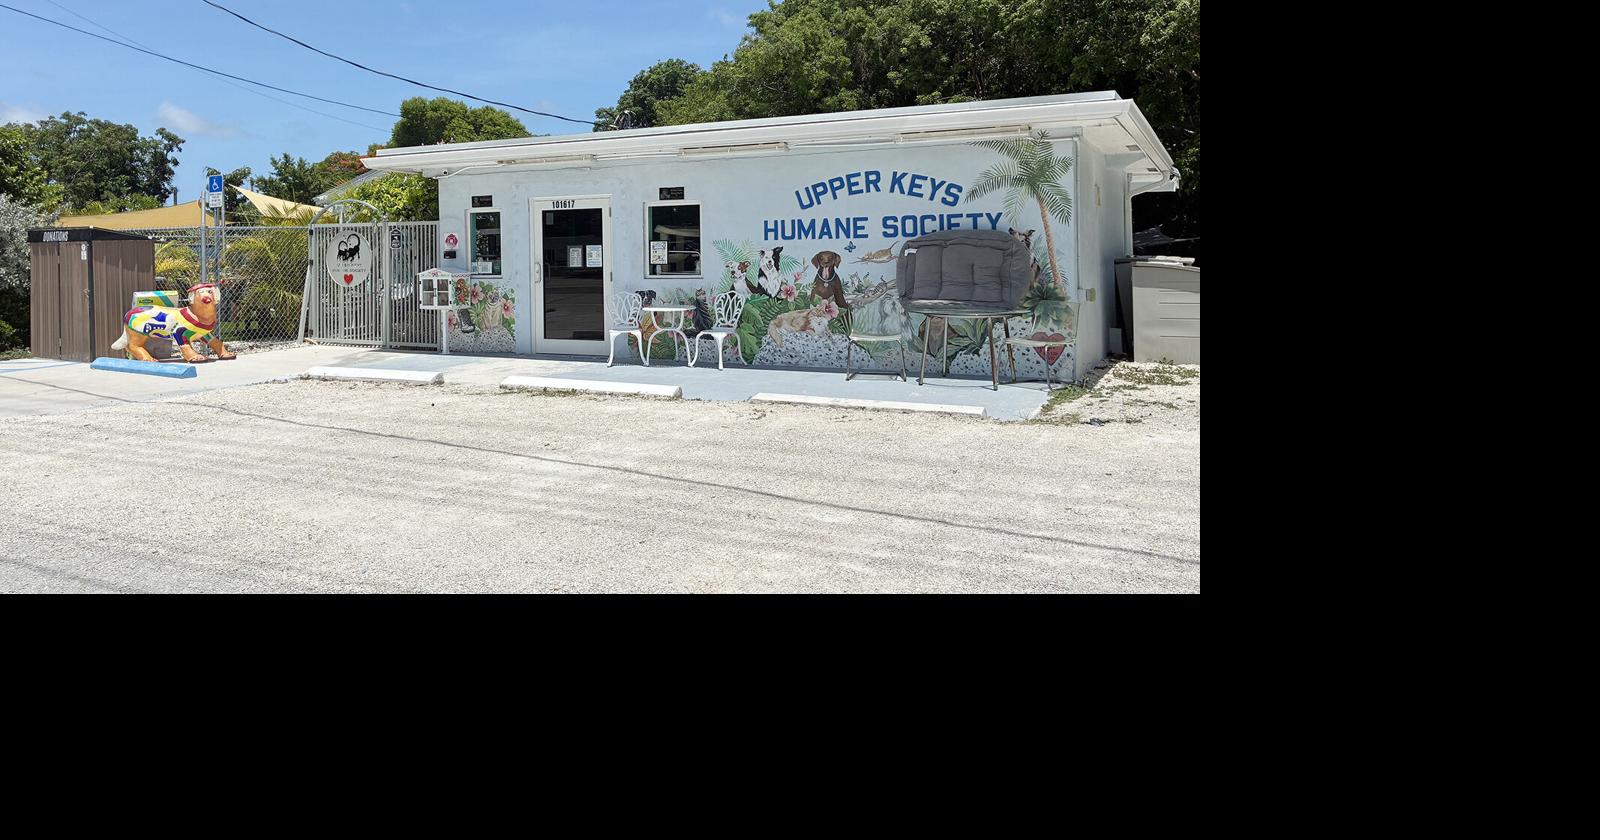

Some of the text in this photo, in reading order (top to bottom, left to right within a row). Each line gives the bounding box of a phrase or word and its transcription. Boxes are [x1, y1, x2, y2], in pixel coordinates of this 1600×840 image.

[795, 170, 963, 210] UPPER KEYS
[552, 200, 575, 209] 101617
[42, 231, 69, 242] DONATIONS
[764, 212, 1003, 241] HUMANE SOCIETY
